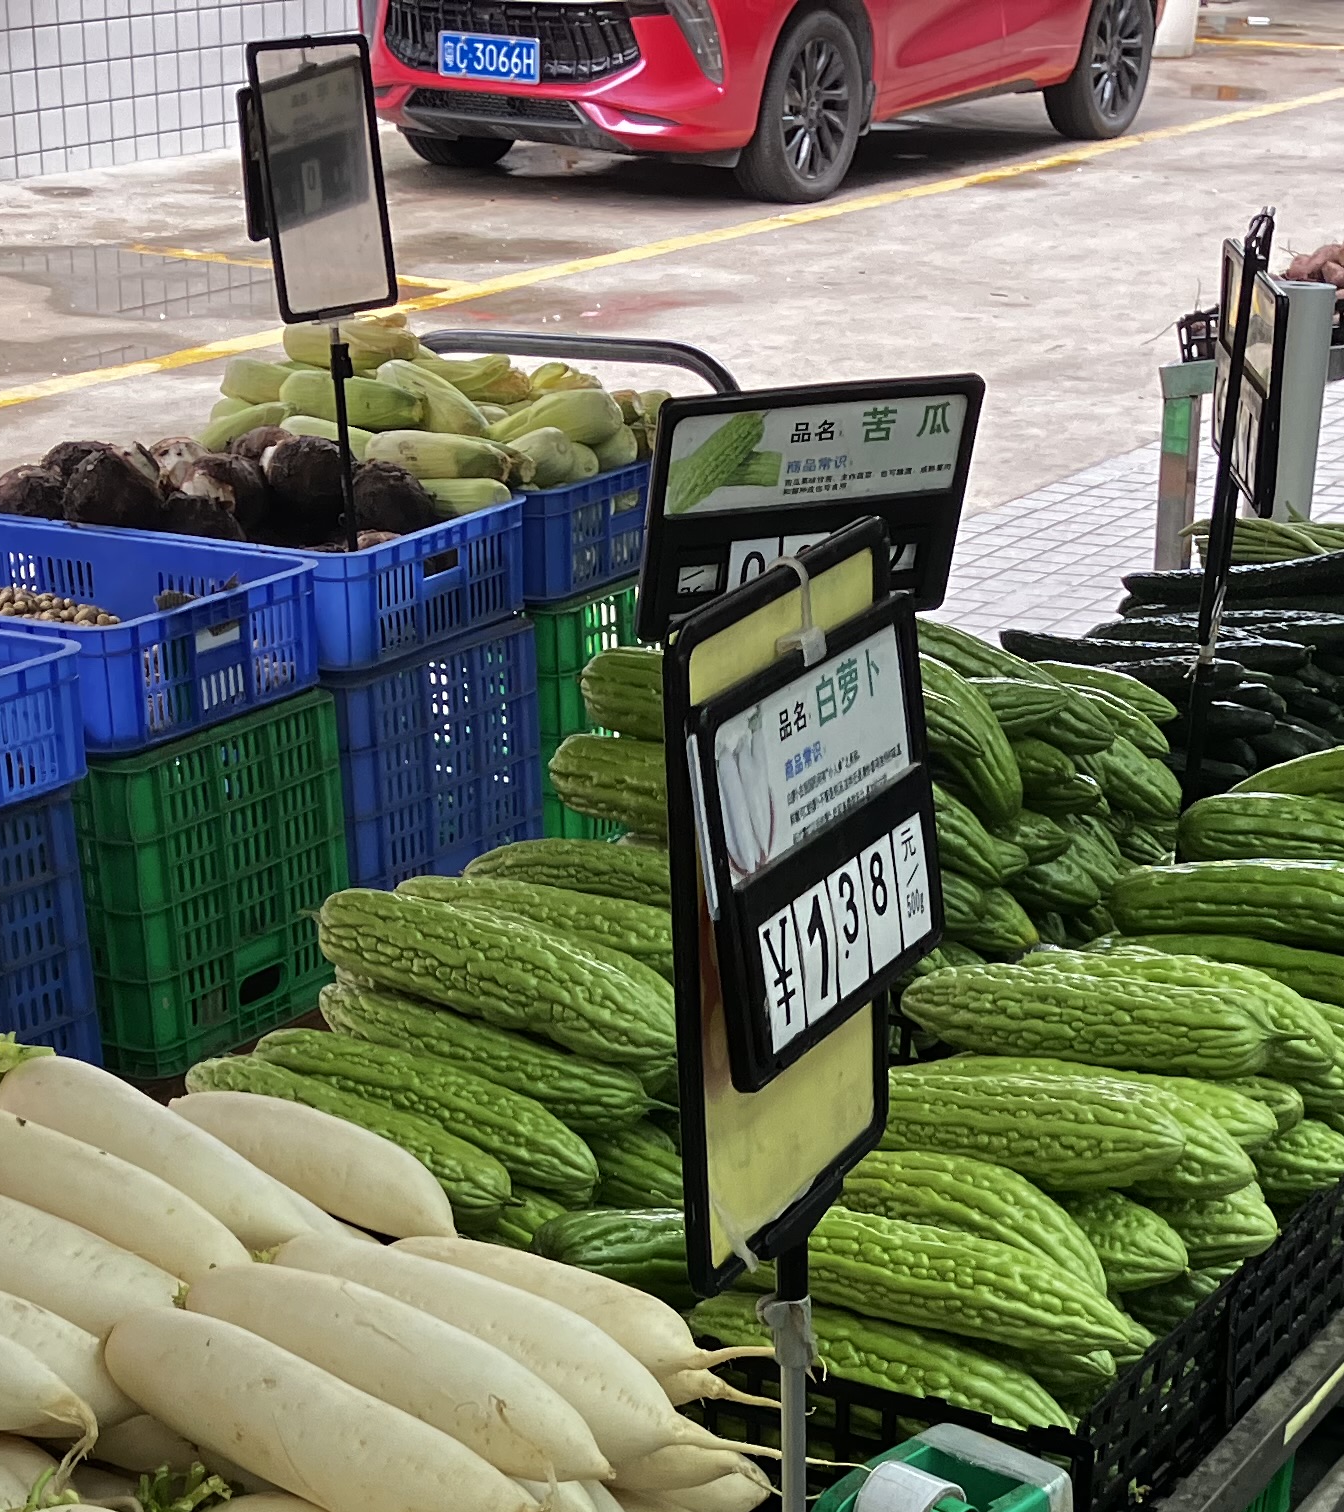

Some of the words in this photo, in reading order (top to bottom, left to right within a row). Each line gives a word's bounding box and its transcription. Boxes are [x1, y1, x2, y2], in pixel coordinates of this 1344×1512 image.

[862, 401, 950, 443] 苦瓜
[816, 649, 880, 727] 白萝卜
